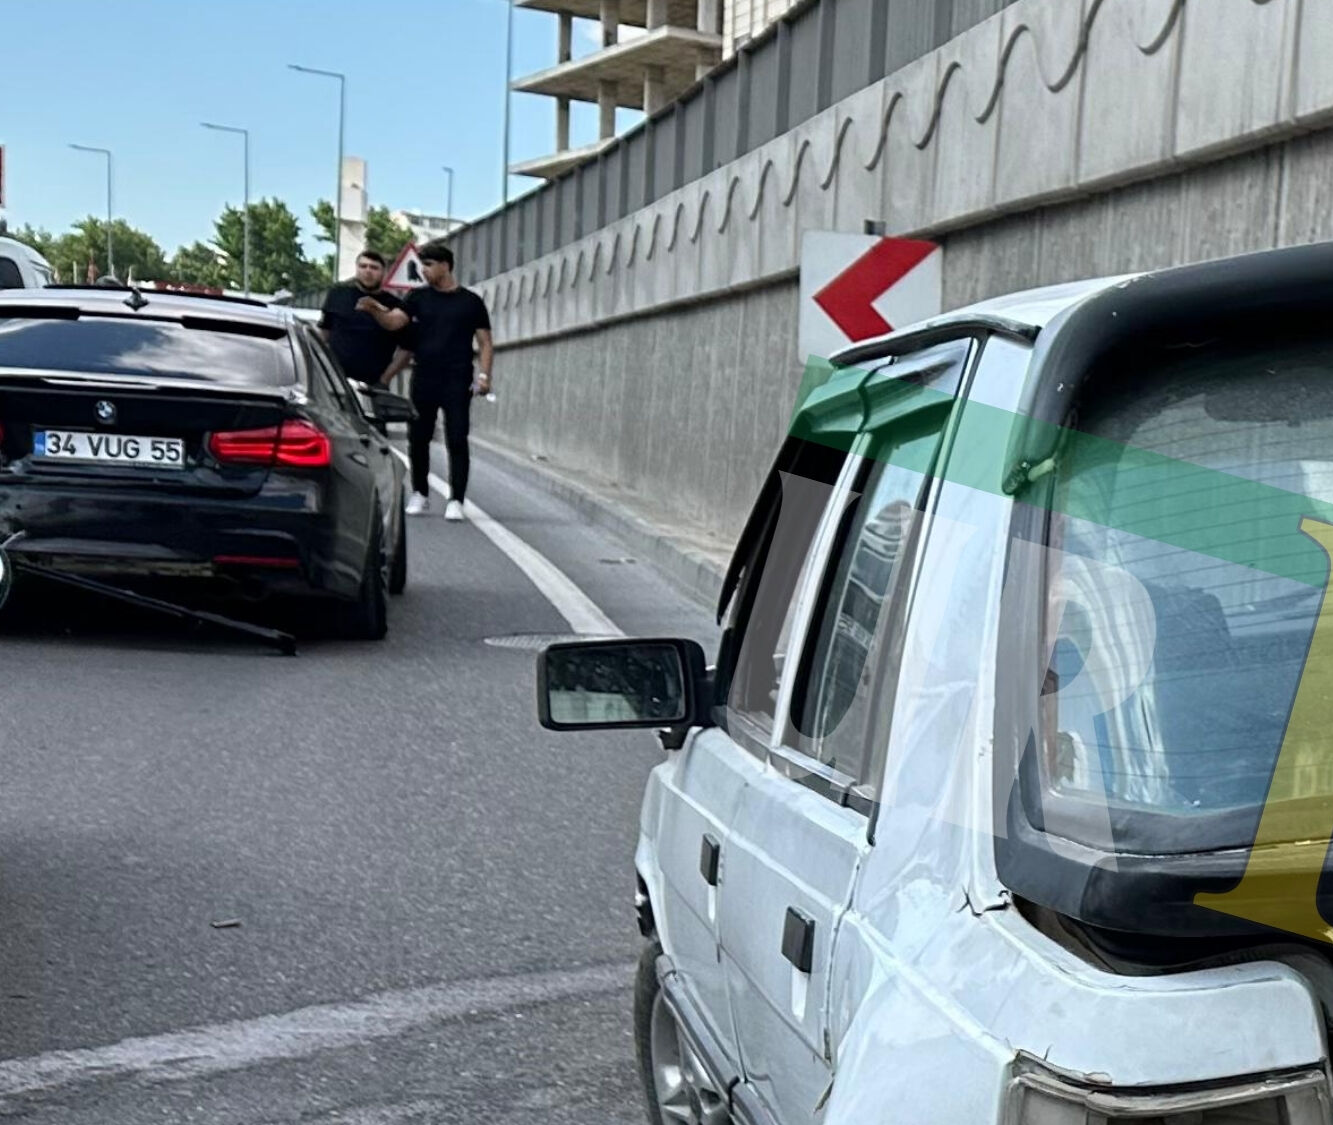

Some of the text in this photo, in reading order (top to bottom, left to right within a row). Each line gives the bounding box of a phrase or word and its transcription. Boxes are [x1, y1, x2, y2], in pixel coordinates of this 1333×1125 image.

[47, 433, 180, 461] 34 VUG 55
